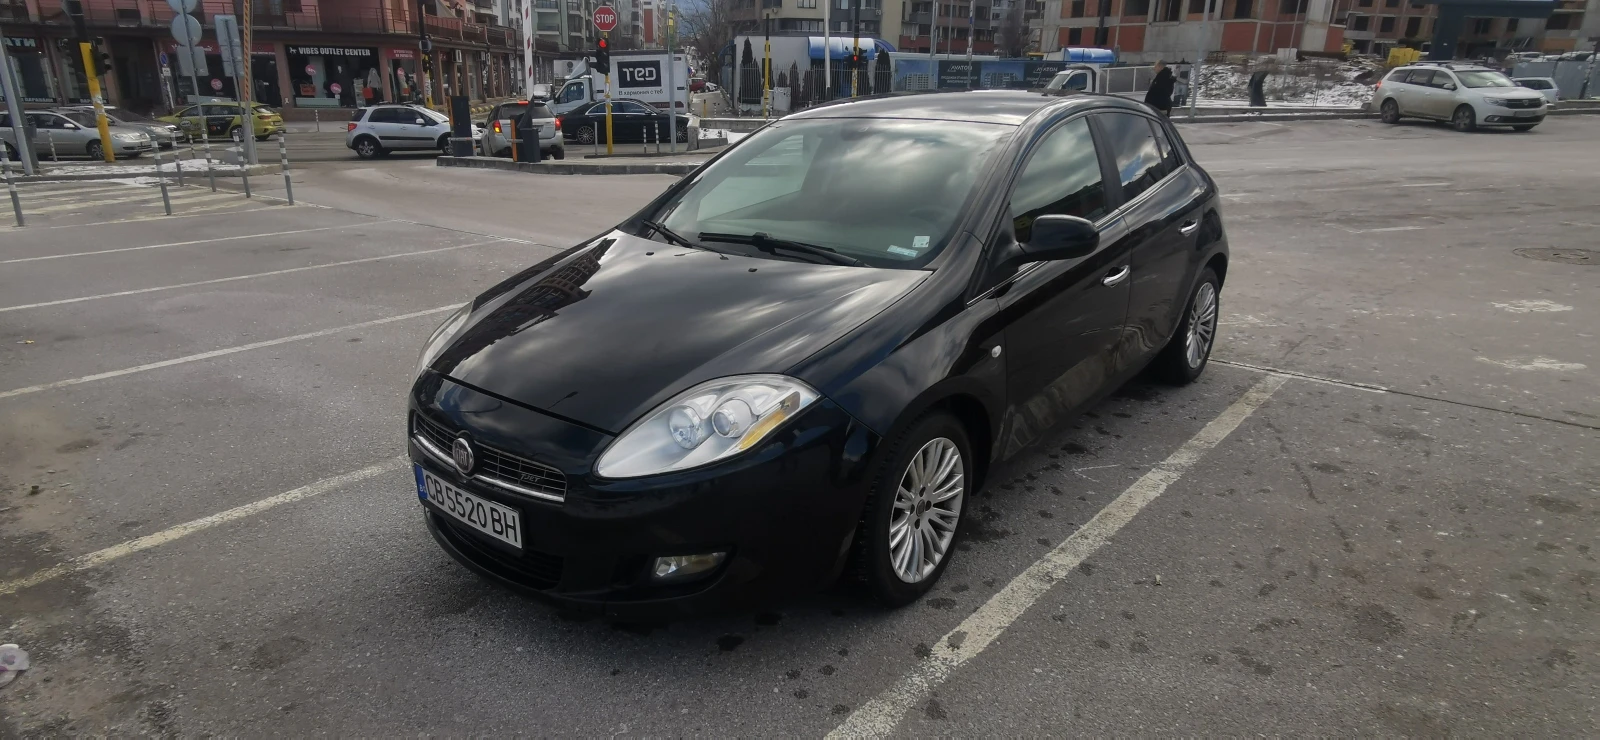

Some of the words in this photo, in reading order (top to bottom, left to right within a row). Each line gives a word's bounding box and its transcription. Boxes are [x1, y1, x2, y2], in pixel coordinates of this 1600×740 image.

[595, 13, 614, 24] STOP
[298, 47, 319, 55] VIBES
[320, 47, 343, 55] OUTLET
[344, 48, 371, 56] CENTER
[455, 448, 468, 467] FIAT
[425, 474, 445, 506] CB
[446, 485, 488, 529] 5520
[490, 506, 518, 543] BH
